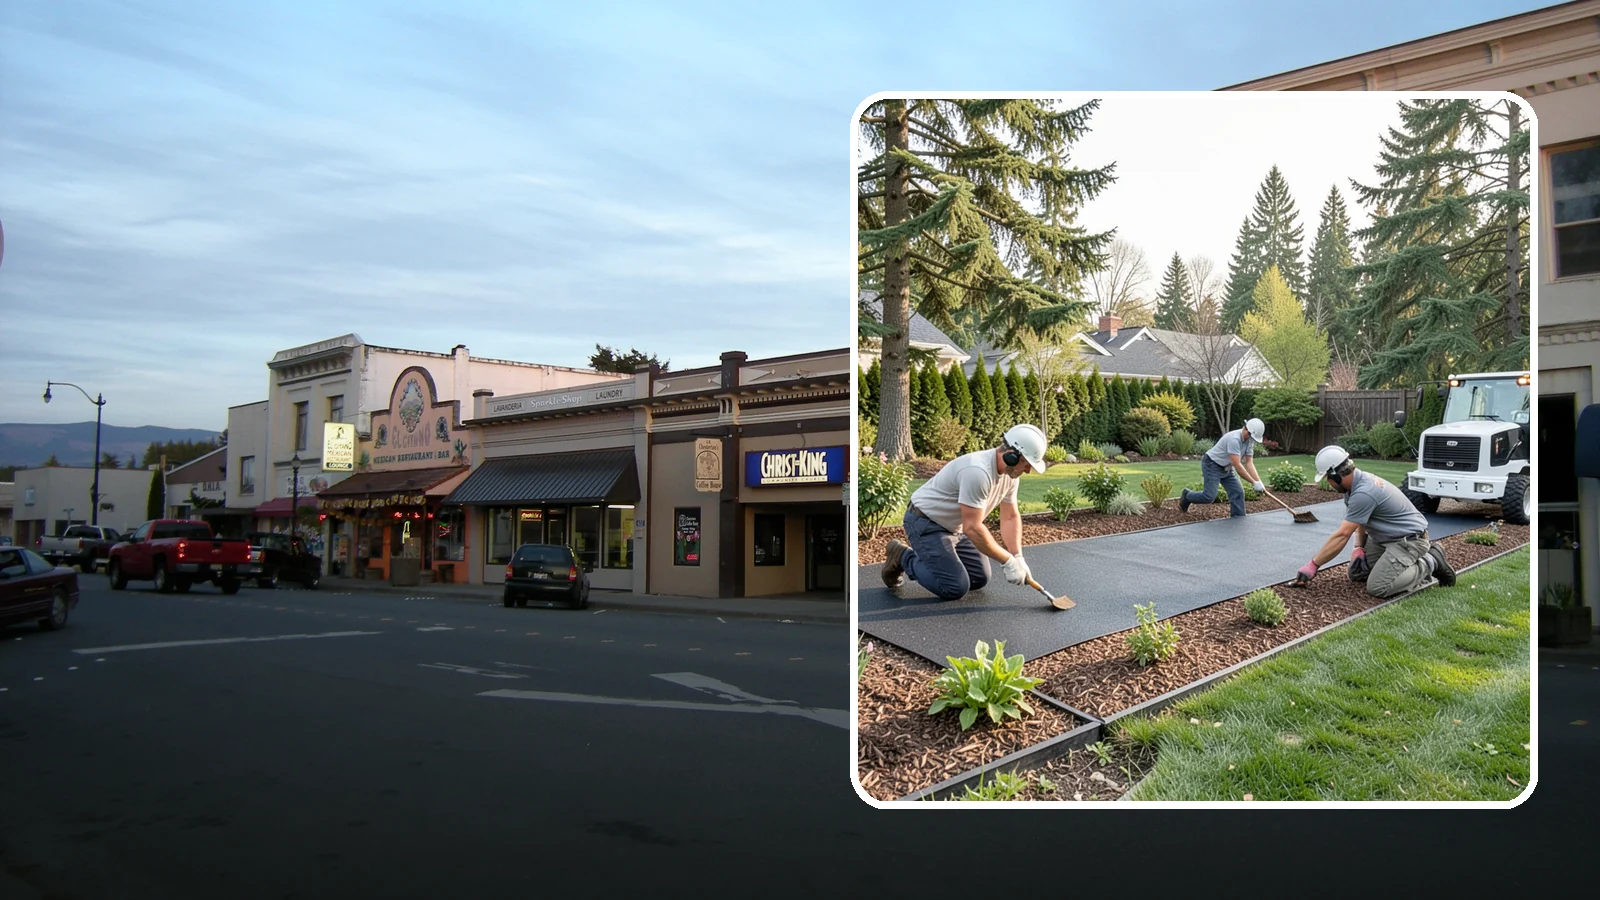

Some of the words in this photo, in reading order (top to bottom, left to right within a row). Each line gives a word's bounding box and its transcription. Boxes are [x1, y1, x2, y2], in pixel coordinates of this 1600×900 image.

[493, 402, 523, 413] LAVANDERIA
[530, 396, 561, 408] Sparkle
[562, 394, 582, 405] Shop
[595, 389, 624, 400] LAUNDRY
[397, 451, 434, 463] RESTAURANT
[438, 450, 450, 459] BAR
